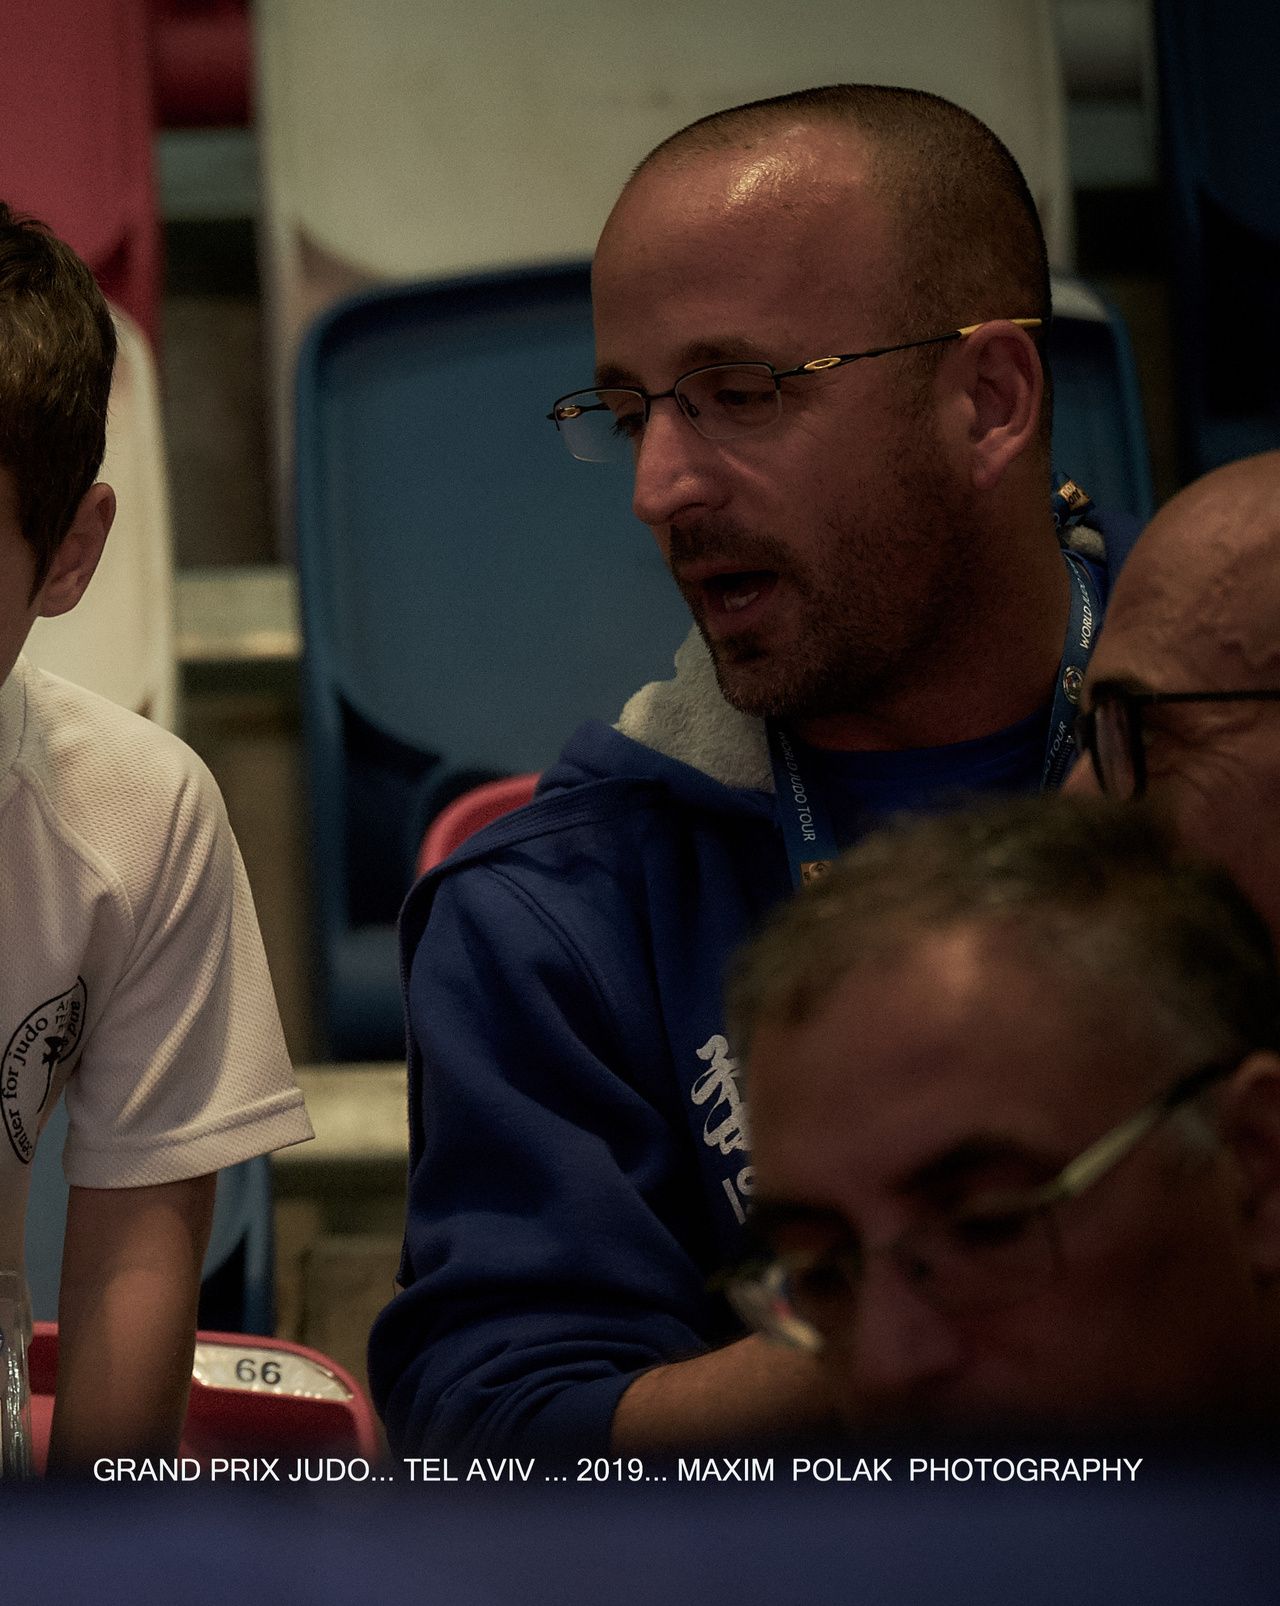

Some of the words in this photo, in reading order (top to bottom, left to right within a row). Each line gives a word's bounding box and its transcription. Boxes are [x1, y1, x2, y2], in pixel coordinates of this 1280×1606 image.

[1079, 605, 1092, 650] WORLD
[777, 730, 798, 772] WORLD
[1049, 721, 1067, 758] TOUR
[790, 772, 808, 804] JUDO
[797, 806, 816, 842] TOUR
[8, 1017, 48, 1067] judo
[2, 1066, 19, 1099] for
[235, 1358, 282, 1386] 66
